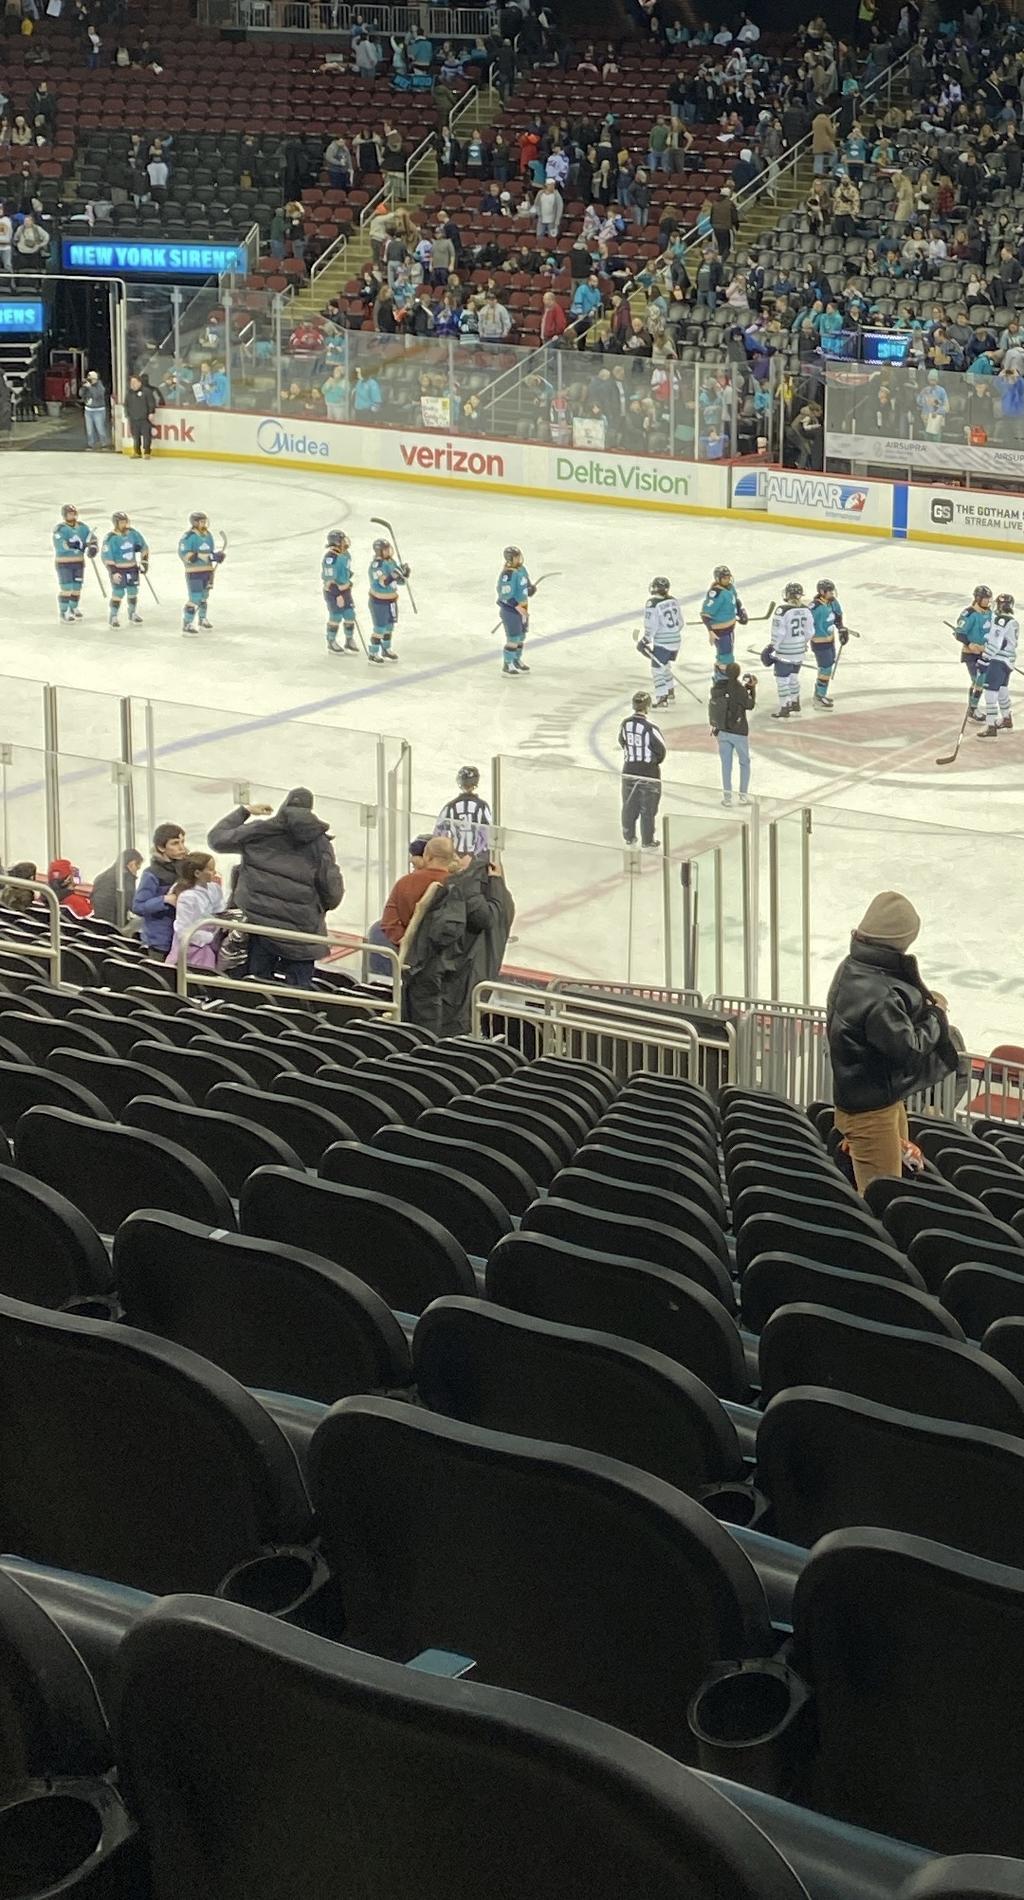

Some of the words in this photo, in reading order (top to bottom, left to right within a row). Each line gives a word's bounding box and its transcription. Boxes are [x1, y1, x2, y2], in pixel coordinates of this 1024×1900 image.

[70, 245, 112, 266] NEW
[115, 247, 166, 267] YORK
[168, 250, 238, 269] SIRENS
[269, 431, 329, 457] Midea
[400, 443, 504, 477] verizon
[556, 458, 689, 496] DeltaVision
[933, 504, 951, 519] GS
[956, 504, 974, 515] THE
[977, 506, 1019, 520] GOTHAM
[965, 516, 1001, 529] STREAM
[1004, 521, 1023, 531] LIVE
